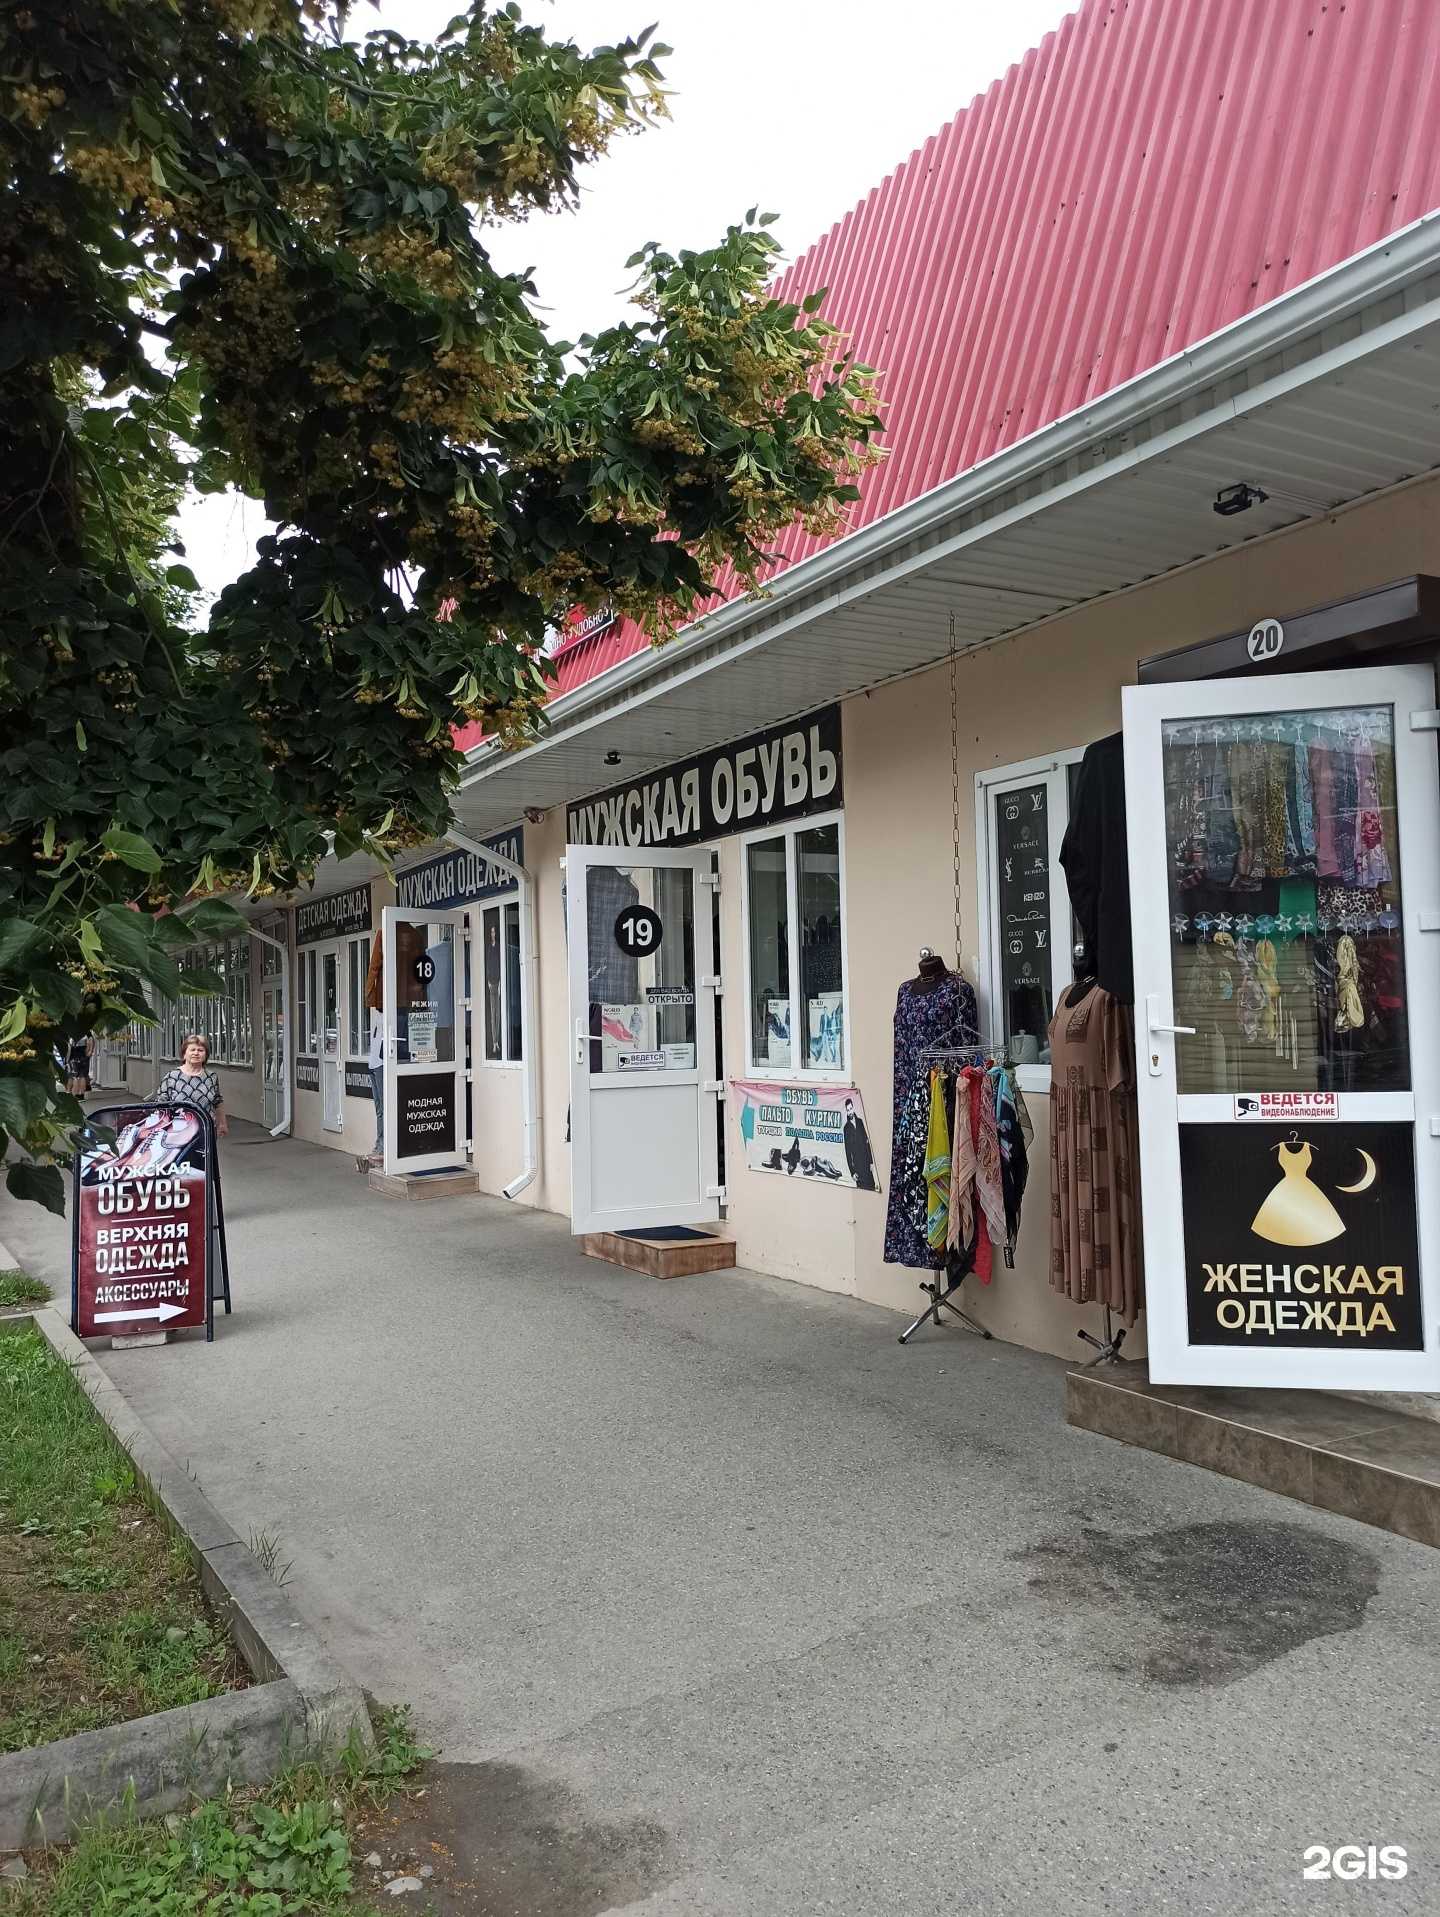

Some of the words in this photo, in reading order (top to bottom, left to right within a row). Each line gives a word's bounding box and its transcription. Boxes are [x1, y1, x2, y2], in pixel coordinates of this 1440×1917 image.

[1252, 625, 1279, 657] 20
[569, 767, 701, 848] МУЖСКАЯ
[711, 724, 837, 825] ОБУВЬ
[398, 860, 455, 908] МУЖСКАЯ
[298, 901, 329, 935] ДЕТСКАЯ
[330, 888, 369, 926] ОДЕЖДА
[622, 918, 653, 946] 19
[416, 962, 433, 978] 18
[1014, 977, 1041, 985] VERSACE
[648, 995, 693, 1004] ОТКРЫТО
[631, 1053, 664, 1063] ВЕДЕТСЯ
[408, 1097, 443, 1108] МОДНАЯ
[786, 1089, 814, 1105] ОБУВЬ
[1260, 1093, 1335, 1107] ВЕДЕТСЯ
[406, 1109, 447, 1120] МУЖСКАЯ
[761, 1106, 792, 1123] ПАЛЬТО
[805, 1109, 841, 1128] КУРТКИ
[1261, 1108, 1335, 1118] ВИДЕОНАБЛЮДЕНИЕ
[408, 1121, 445, 1133] ОДЕЖДА
[816, 1131, 844, 1143] РОССИЯ
[98, 1161, 191, 1181] МУЖСКАЯ
[98, 1178, 191, 1215] ОБУВЬ
[96, 1223, 189, 1245] ВЕРХНЯЯ
[95, 1242, 189, 1275] ОДЕЖДА
[1202, 1264, 1404, 1295] ЖЕНСКАЯ
[95, 1279, 190, 1304] АКСЕССУАРЫ
[1216, 1299, 1396, 1337] ОДЕЖДА
